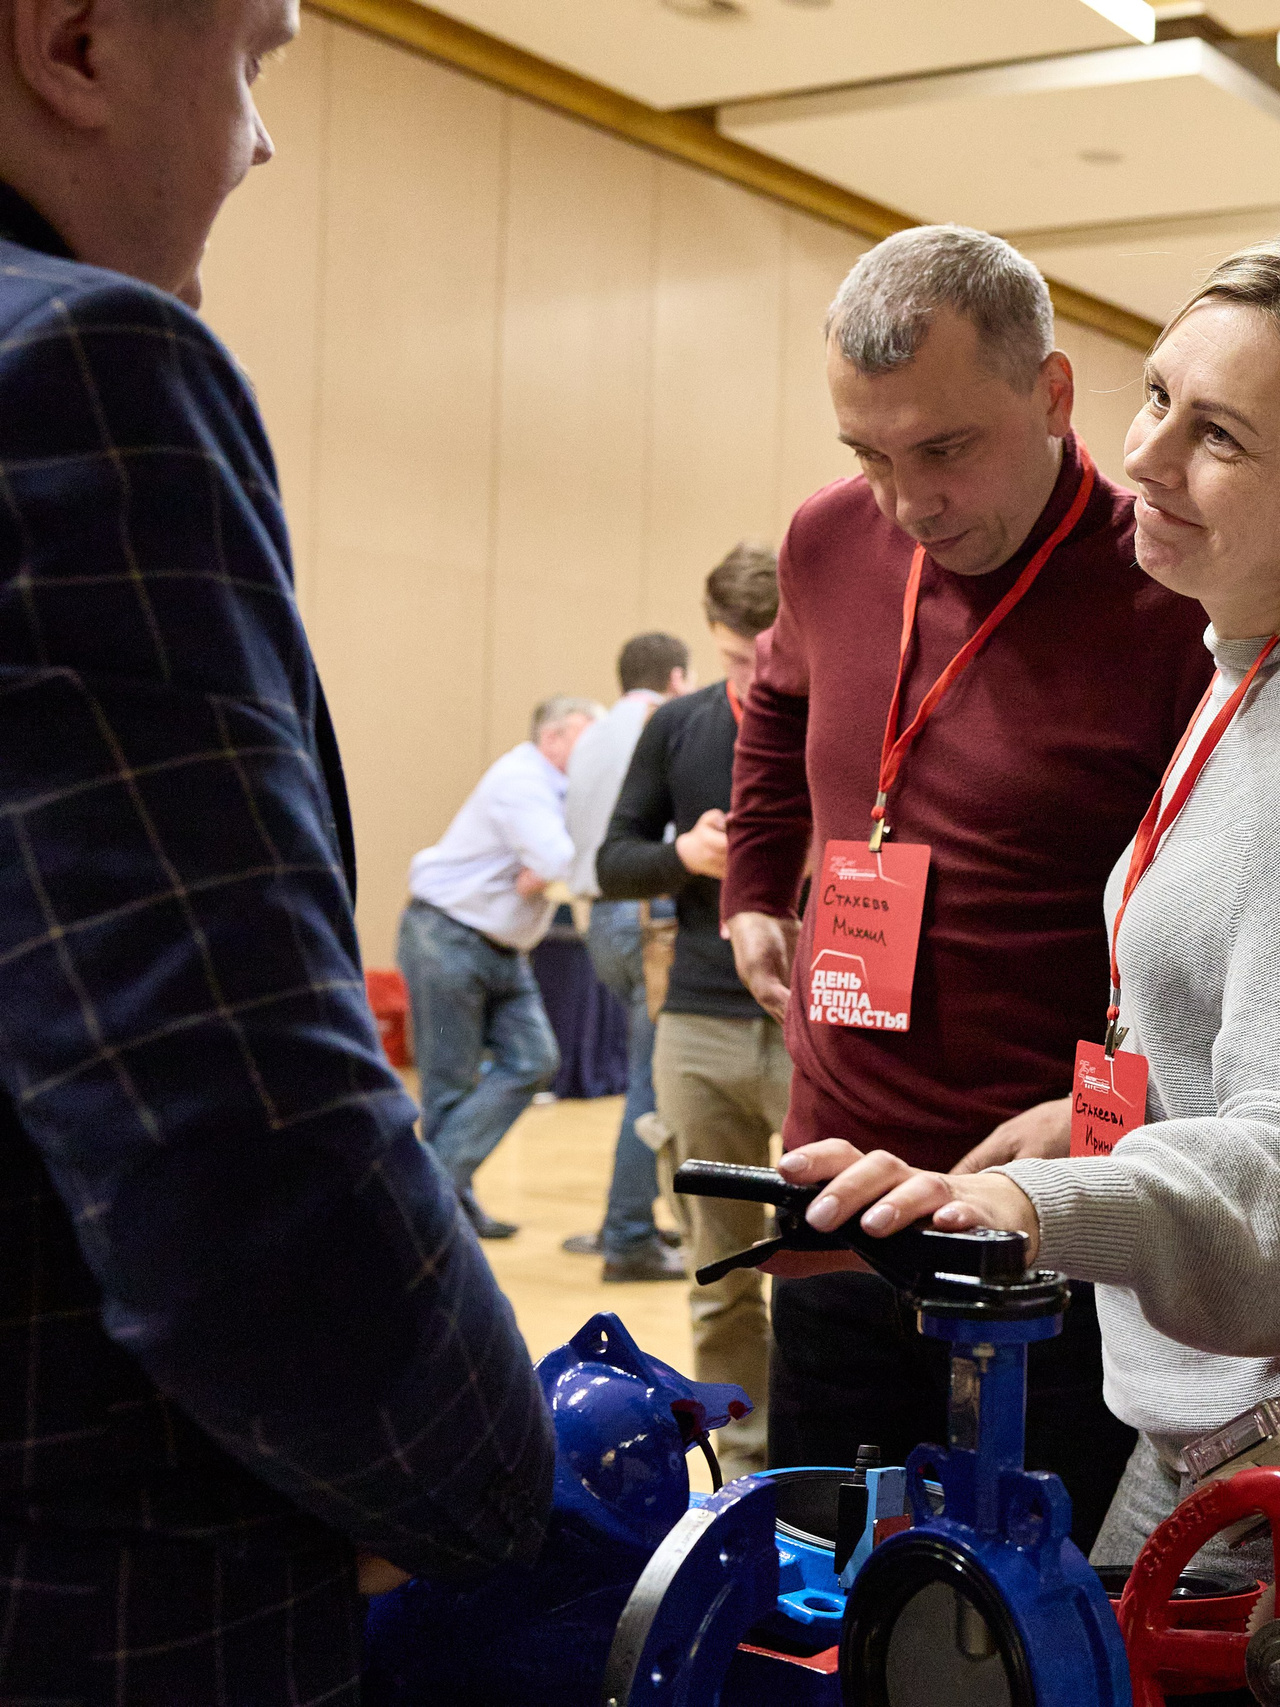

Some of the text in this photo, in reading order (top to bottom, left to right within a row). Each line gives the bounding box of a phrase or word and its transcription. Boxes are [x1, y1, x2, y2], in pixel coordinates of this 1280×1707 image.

[811, 970, 862, 990] ДЕНЬ
[811, 989, 872, 1010] ТЕПЛА
[809, 1005, 908, 1030] И СЧАСТЬЯ
